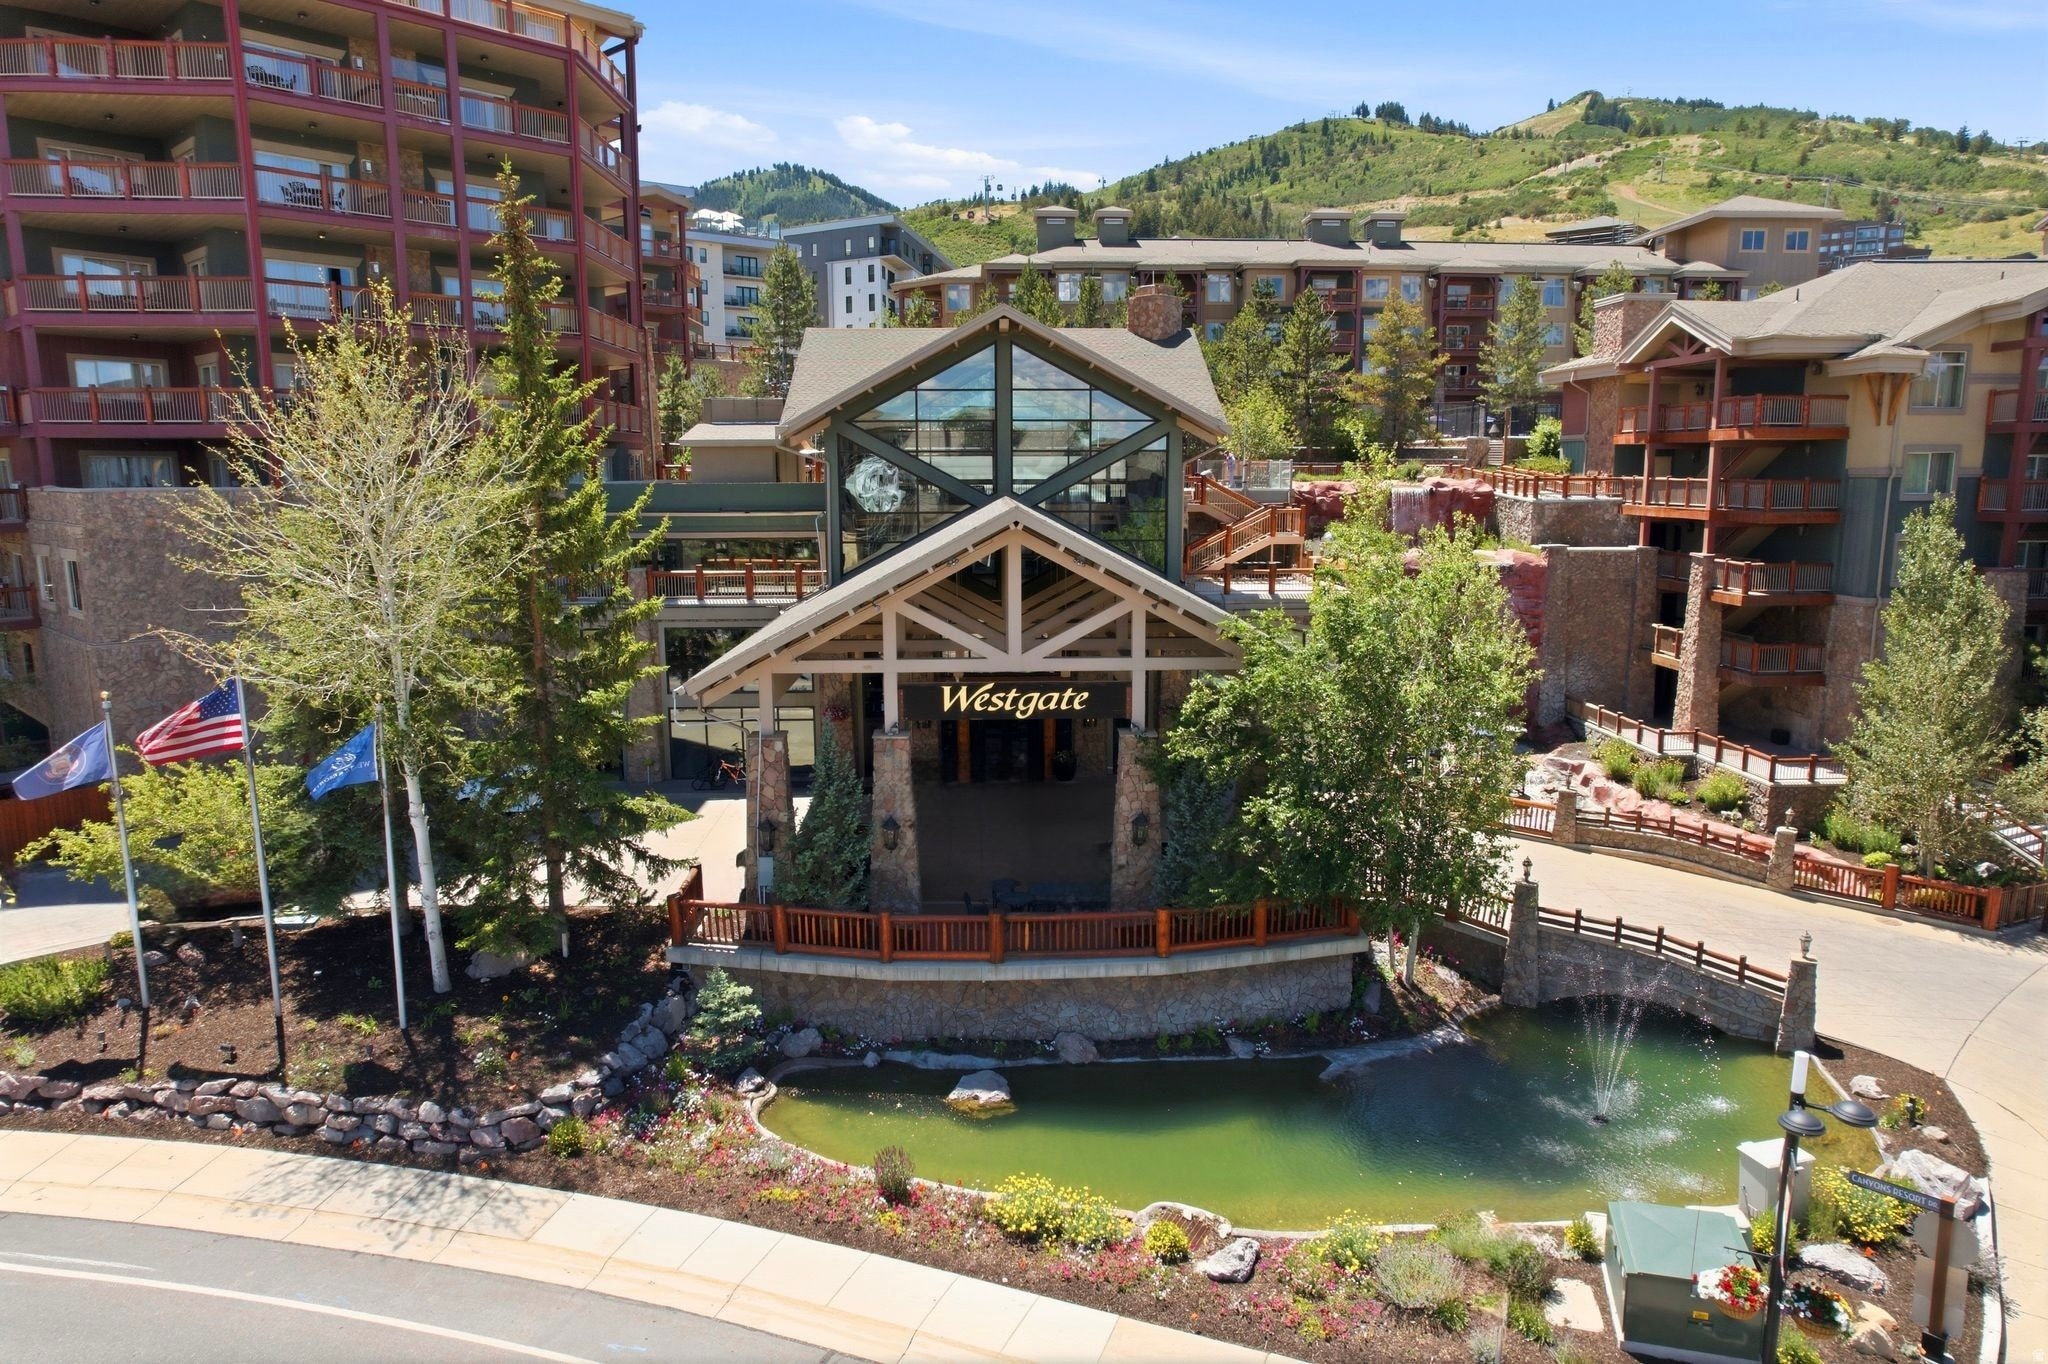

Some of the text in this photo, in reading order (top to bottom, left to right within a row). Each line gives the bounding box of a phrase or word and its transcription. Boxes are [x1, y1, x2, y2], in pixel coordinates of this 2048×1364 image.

[941, 682, 1089, 719] Westgate
[1851, 1174, 1891, 1193] CANYONS
[1893, 1188, 1926, 1205] RESORT
